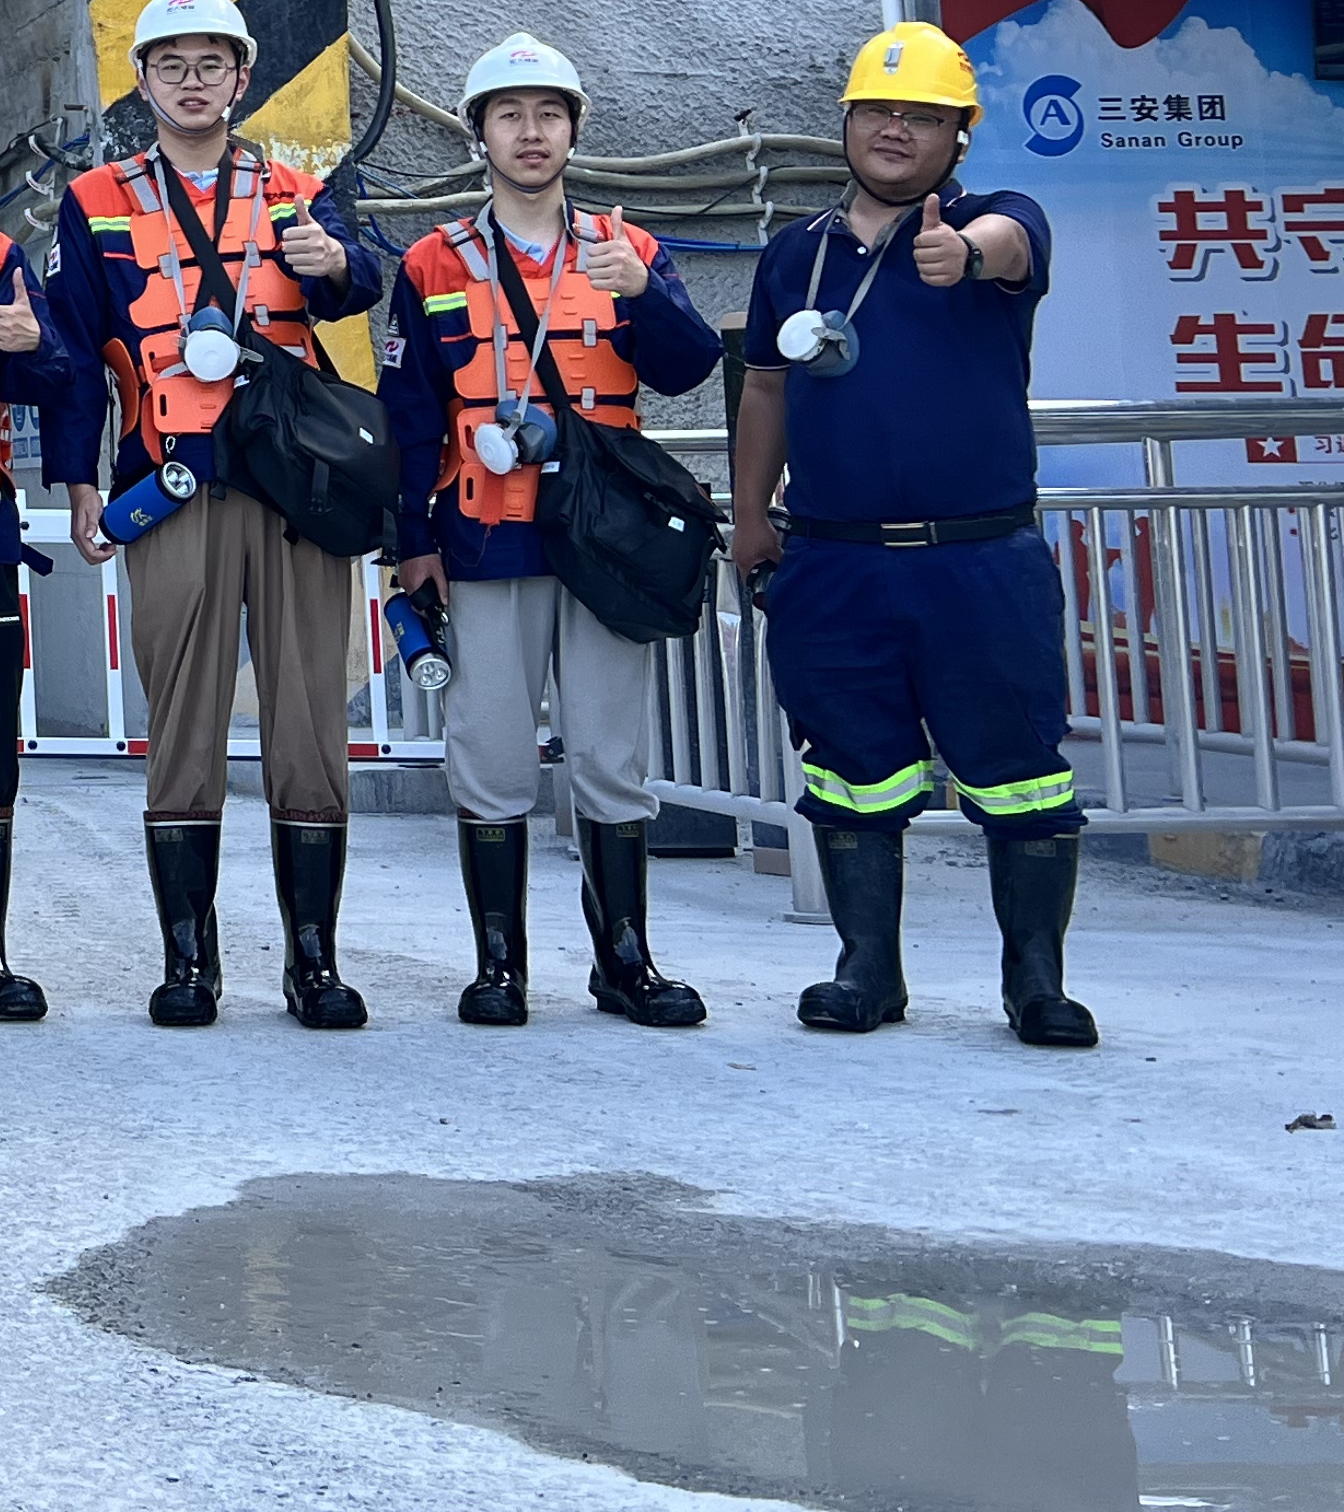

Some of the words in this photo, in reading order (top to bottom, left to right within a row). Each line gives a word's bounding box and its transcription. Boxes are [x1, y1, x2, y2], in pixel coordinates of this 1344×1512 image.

[1097, 94, 1226, 122] 三安集团
[1100, 132, 1166, 148] Sanan
[1177, 131, 1244, 150] Group
